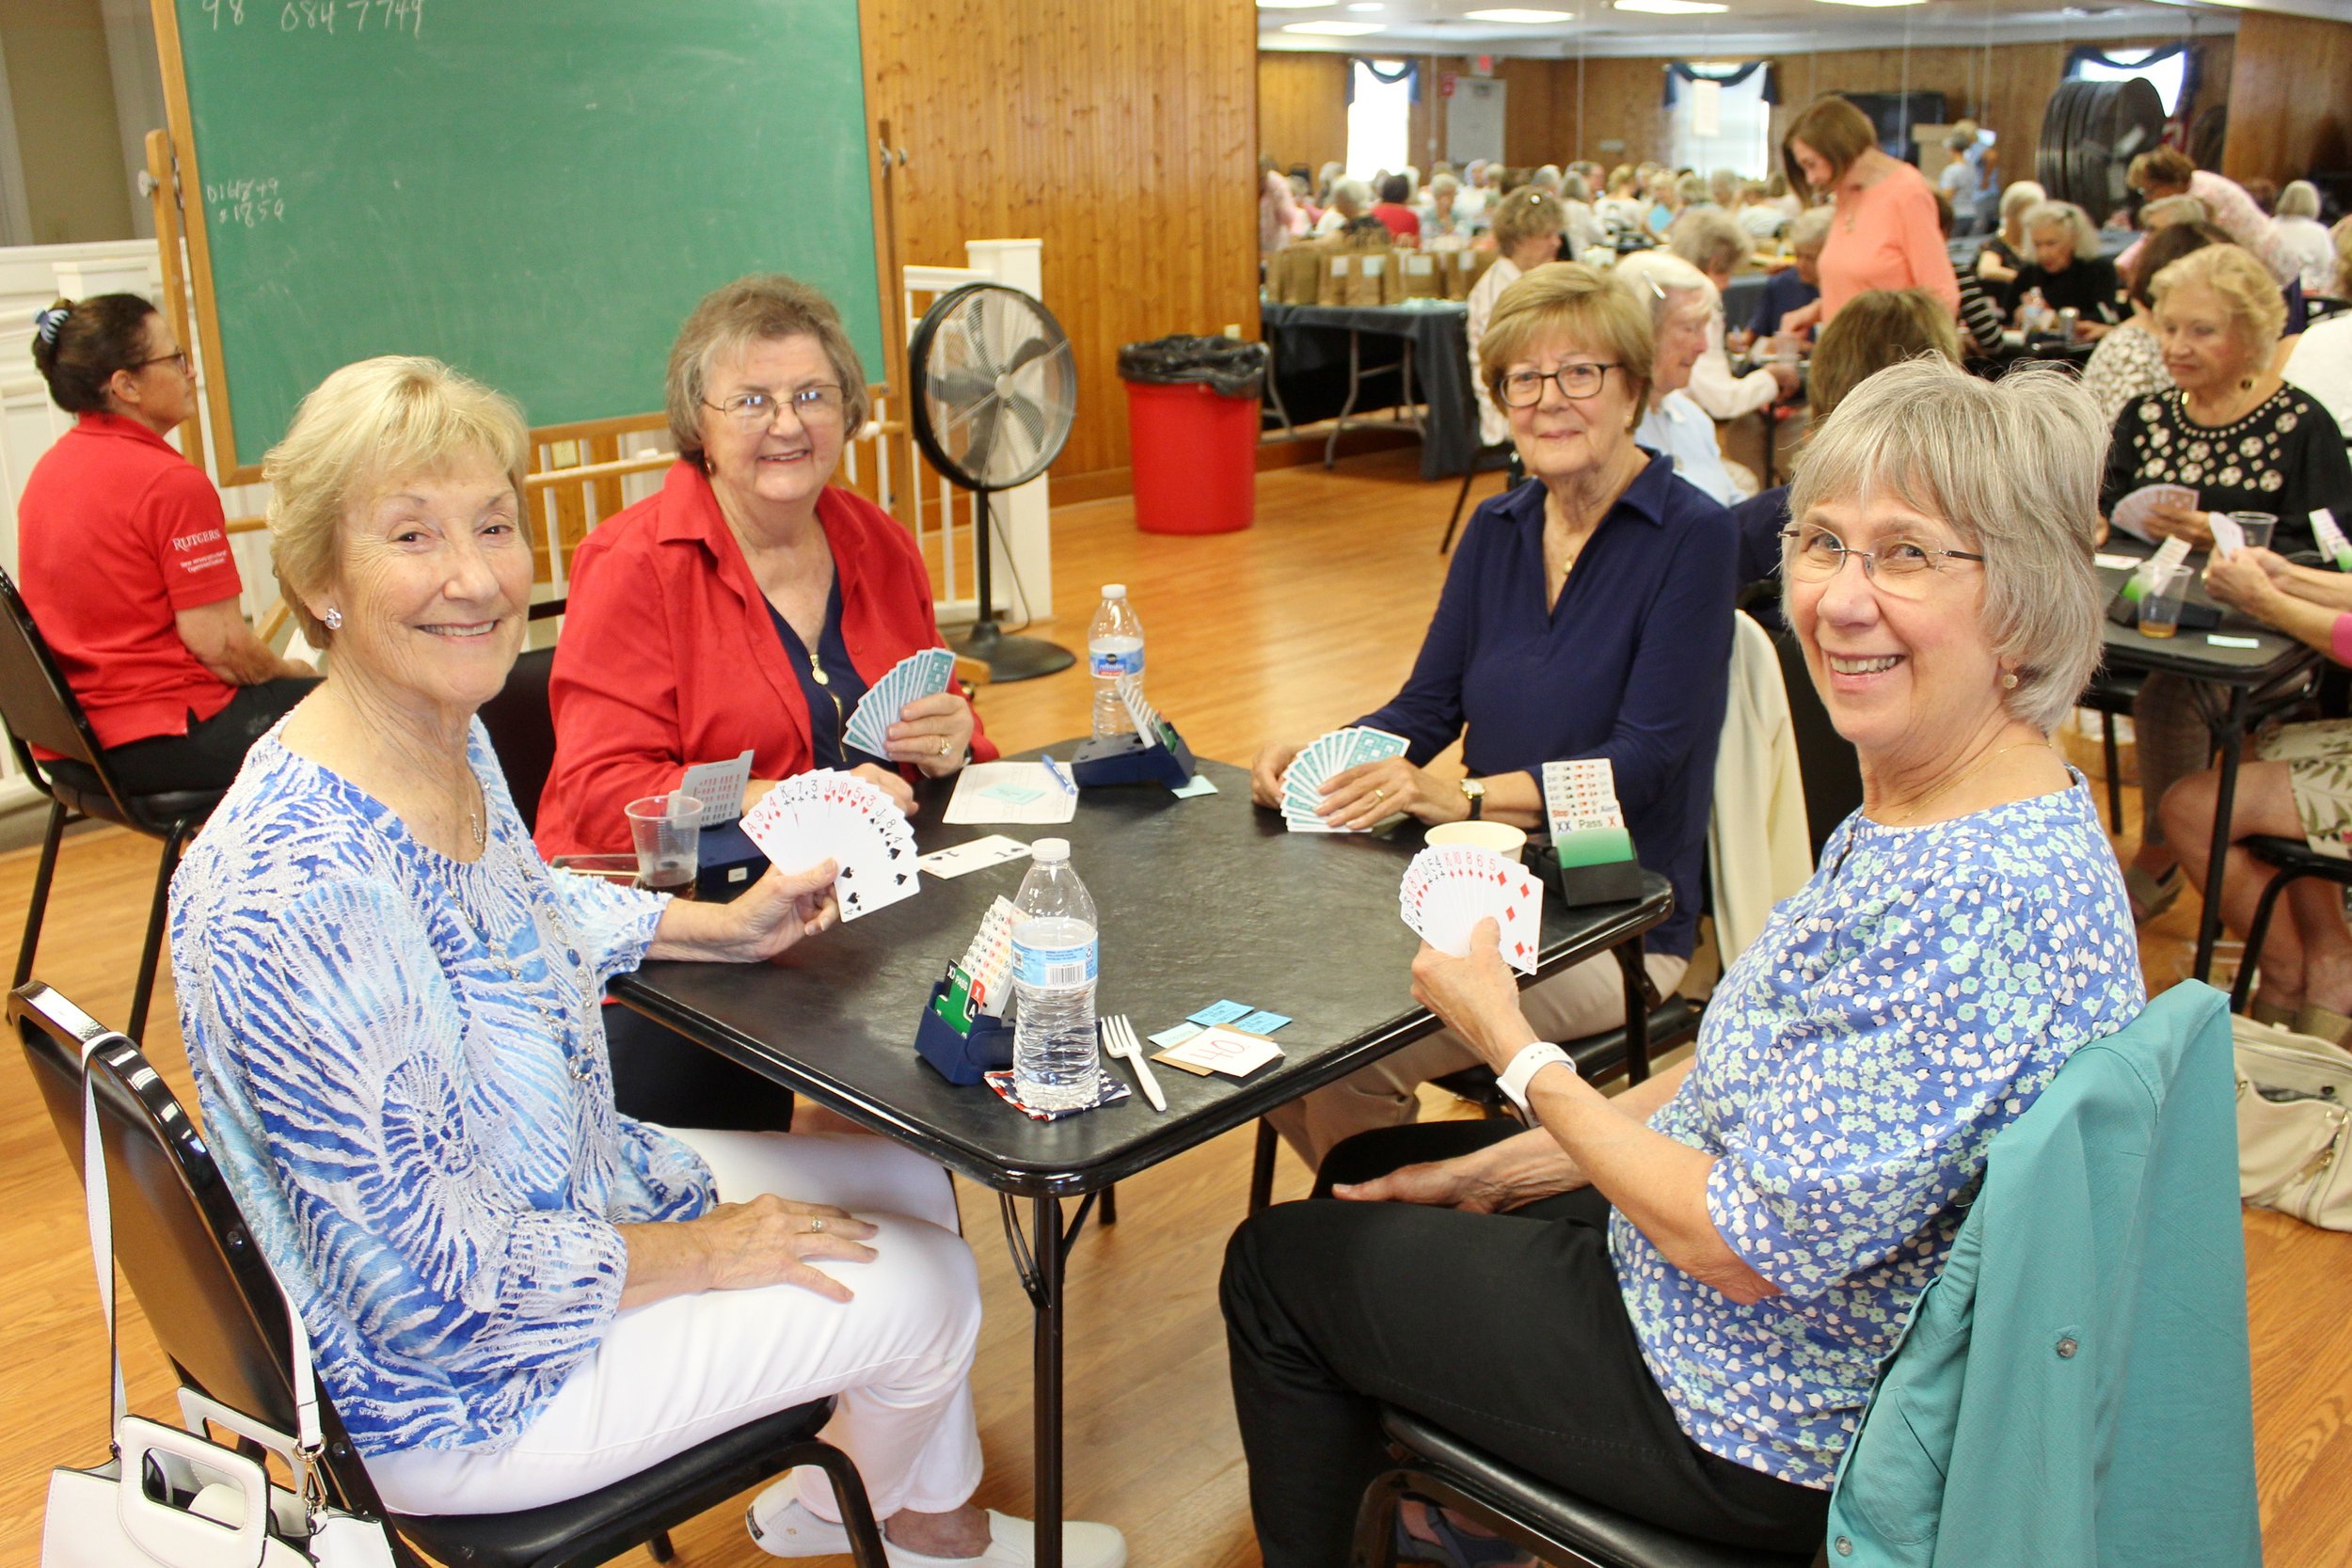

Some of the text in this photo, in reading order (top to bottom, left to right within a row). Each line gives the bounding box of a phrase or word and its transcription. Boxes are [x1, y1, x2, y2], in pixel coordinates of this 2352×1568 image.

[172, 529, 221, 553] RUTGERS
[810, 779, 818, 792] 3
[838, 781, 848, 795] 10
[853, 786, 863, 800] 5
[769, 795, 777, 808] 4
[866, 794, 876, 807] 3
[754, 809, 764, 822] 9
[746, 821, 756, 832] A
[886, 818, 896, 829] 8
[1556, 816, 1616, 832] XX Pass X
[955, 974, 968, 991] PASS
[974, 986, 981, 999] X
[968, 1004, 977, 1018] A
